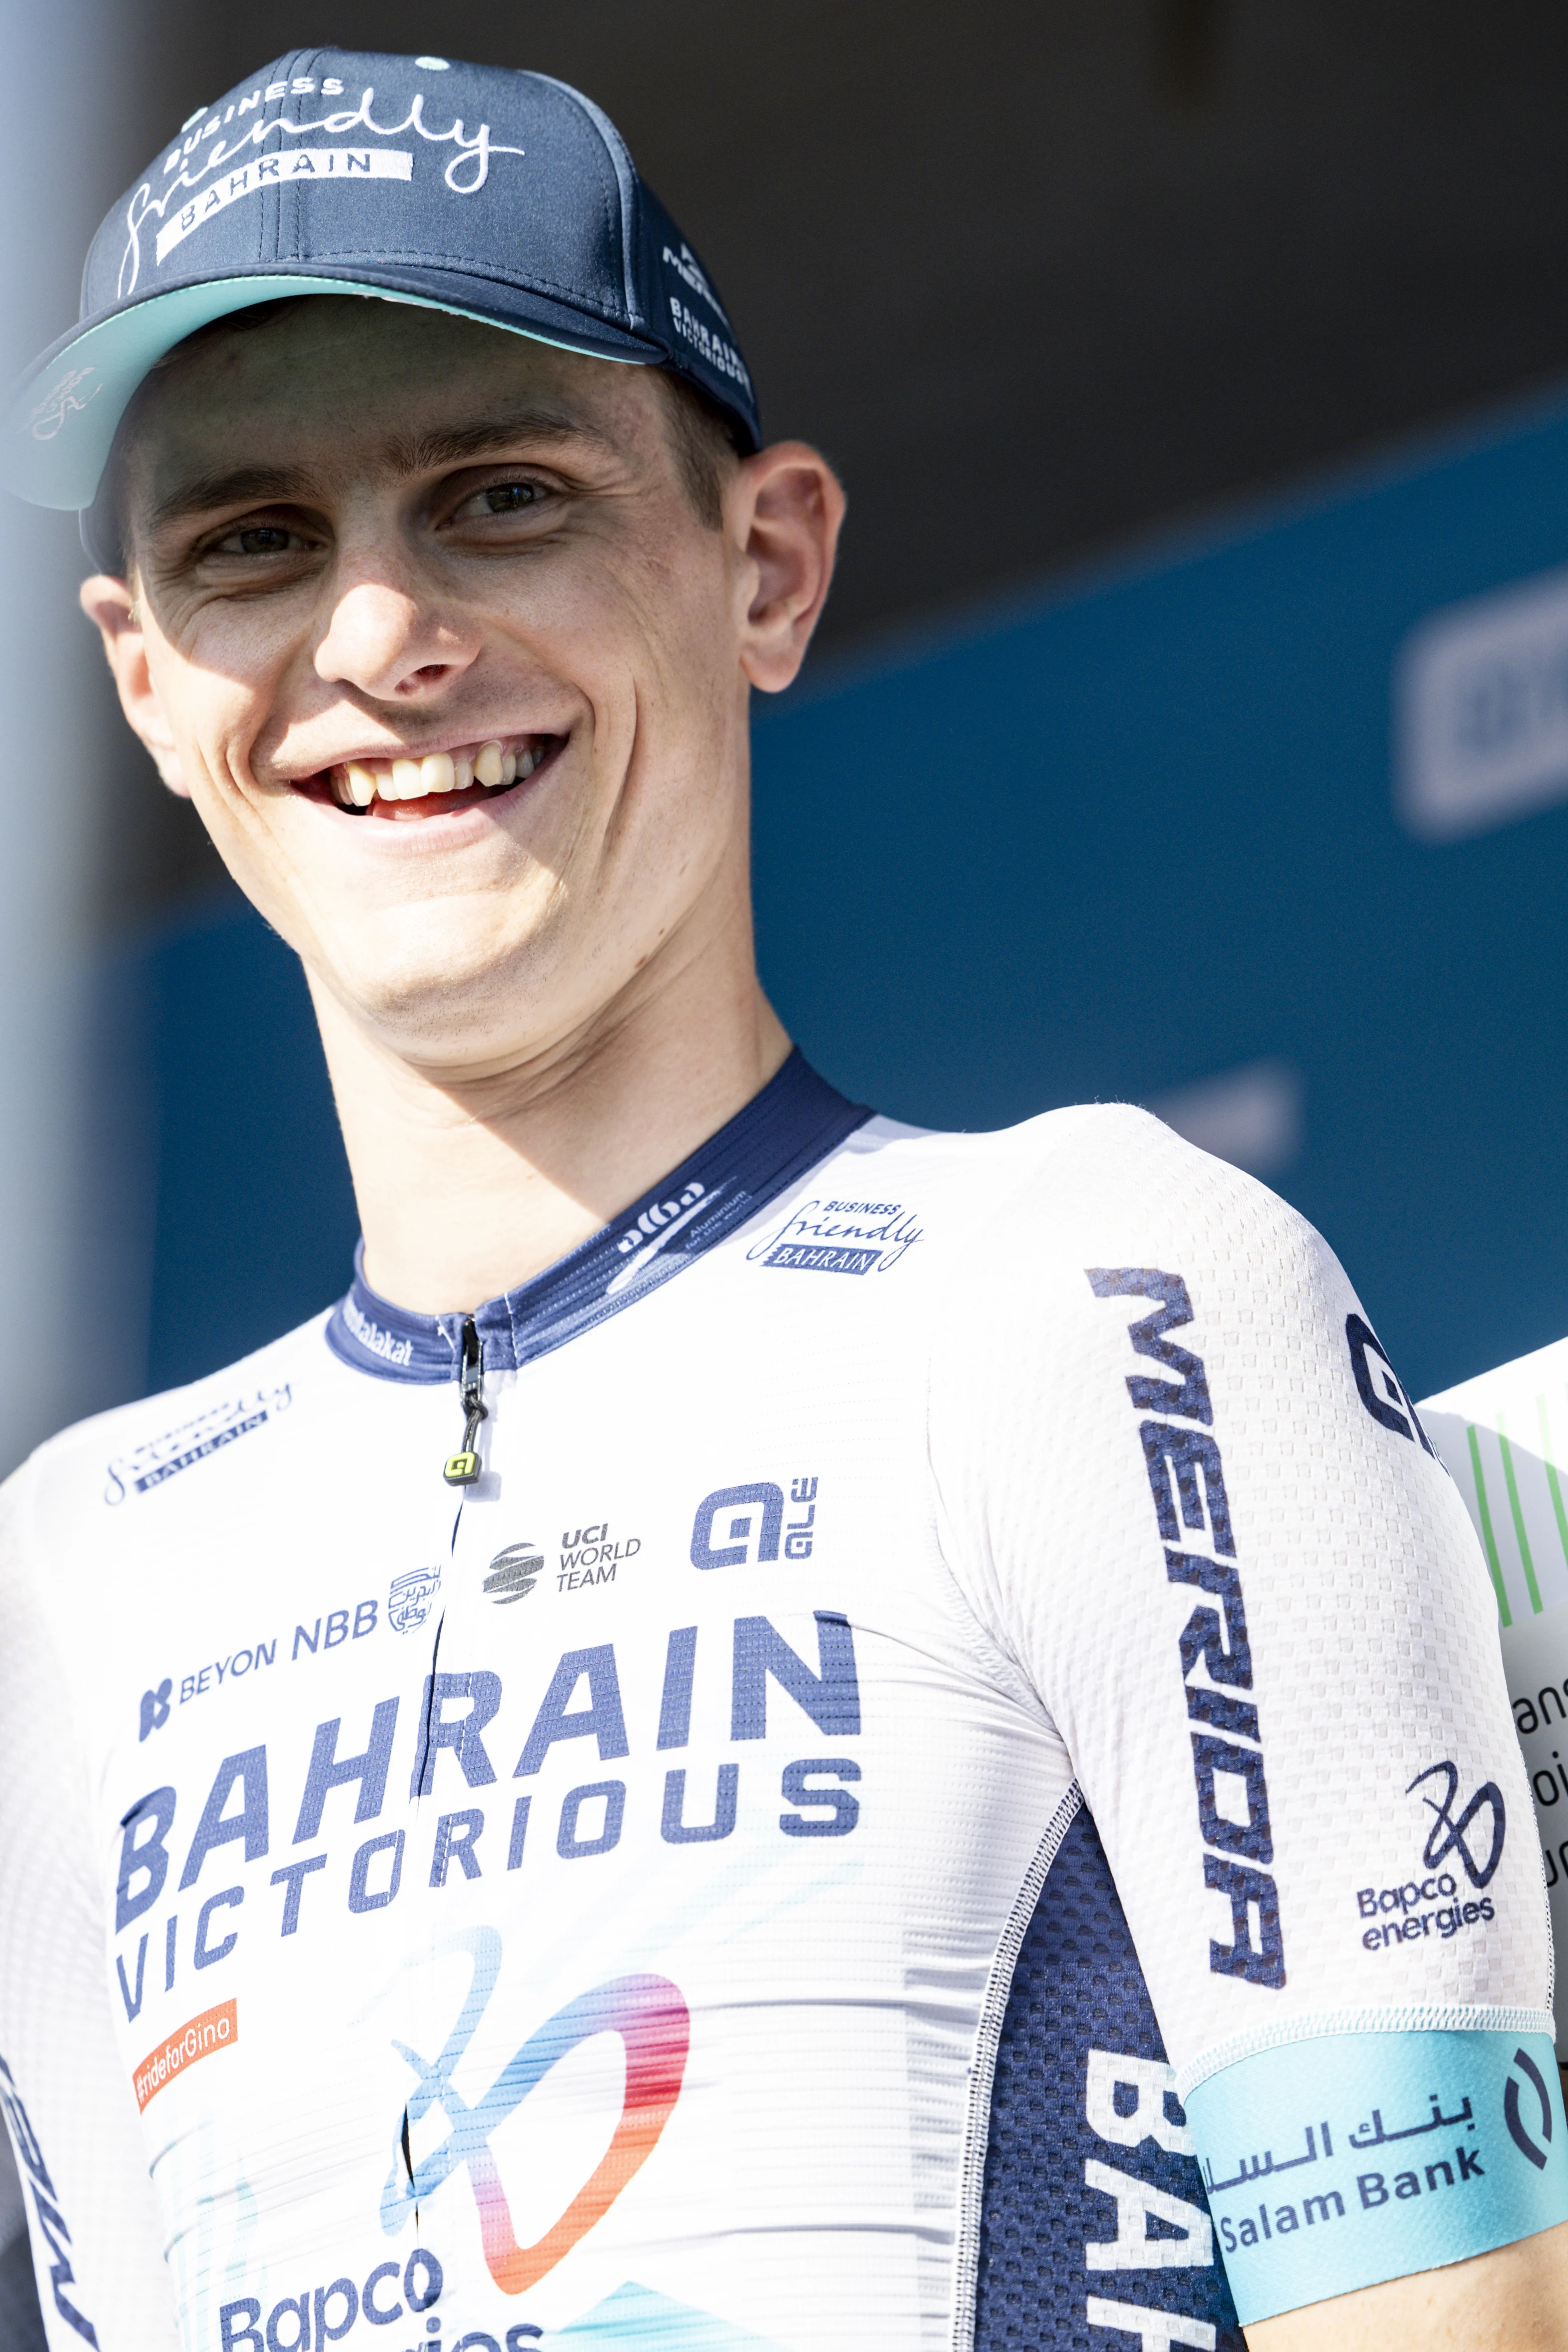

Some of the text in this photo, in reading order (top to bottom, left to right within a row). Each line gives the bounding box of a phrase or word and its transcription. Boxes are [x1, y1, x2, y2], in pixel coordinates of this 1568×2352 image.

[164, 77, 344, 174] BUSINESS
[117, 87, 525, 299] friendly
[179, 153, 371, 232] BAHRAIN
[669, 296, 743, 372] BAHRAIN
[690, 1190, 746, 1238] Aluminium
[746, 1200, 924, 1272] friendly
[823, 1200, 902, 1215] BUSINESS
[774, 1247, 876, 1271] BAHRAIN
[559, 1537, 642, 1571] WORLD
[561, 1523, 609, 1549] UCI
[556, 1563, 618, 1593] TEAM
[179, 1599, 379, 1705] BEYON NBB
[1084, 1266, 1287, 1990] MERIDA
[113, 1609, 862, 1934] BAHRAIN
[116, 1758, 862, 2023] VICTORIOUS
[1357, 1873, 1457, 1919] Bapco
[1362, 1897, 1495, 1951] energies
[137, 2017, 230, 2105] #rideforGino
[1348, 2093, 1476, 2150] بنك
[1220, 2145, 1486, 2254] Salam Bank
[219, 2248, 444, 2352] Bapco
